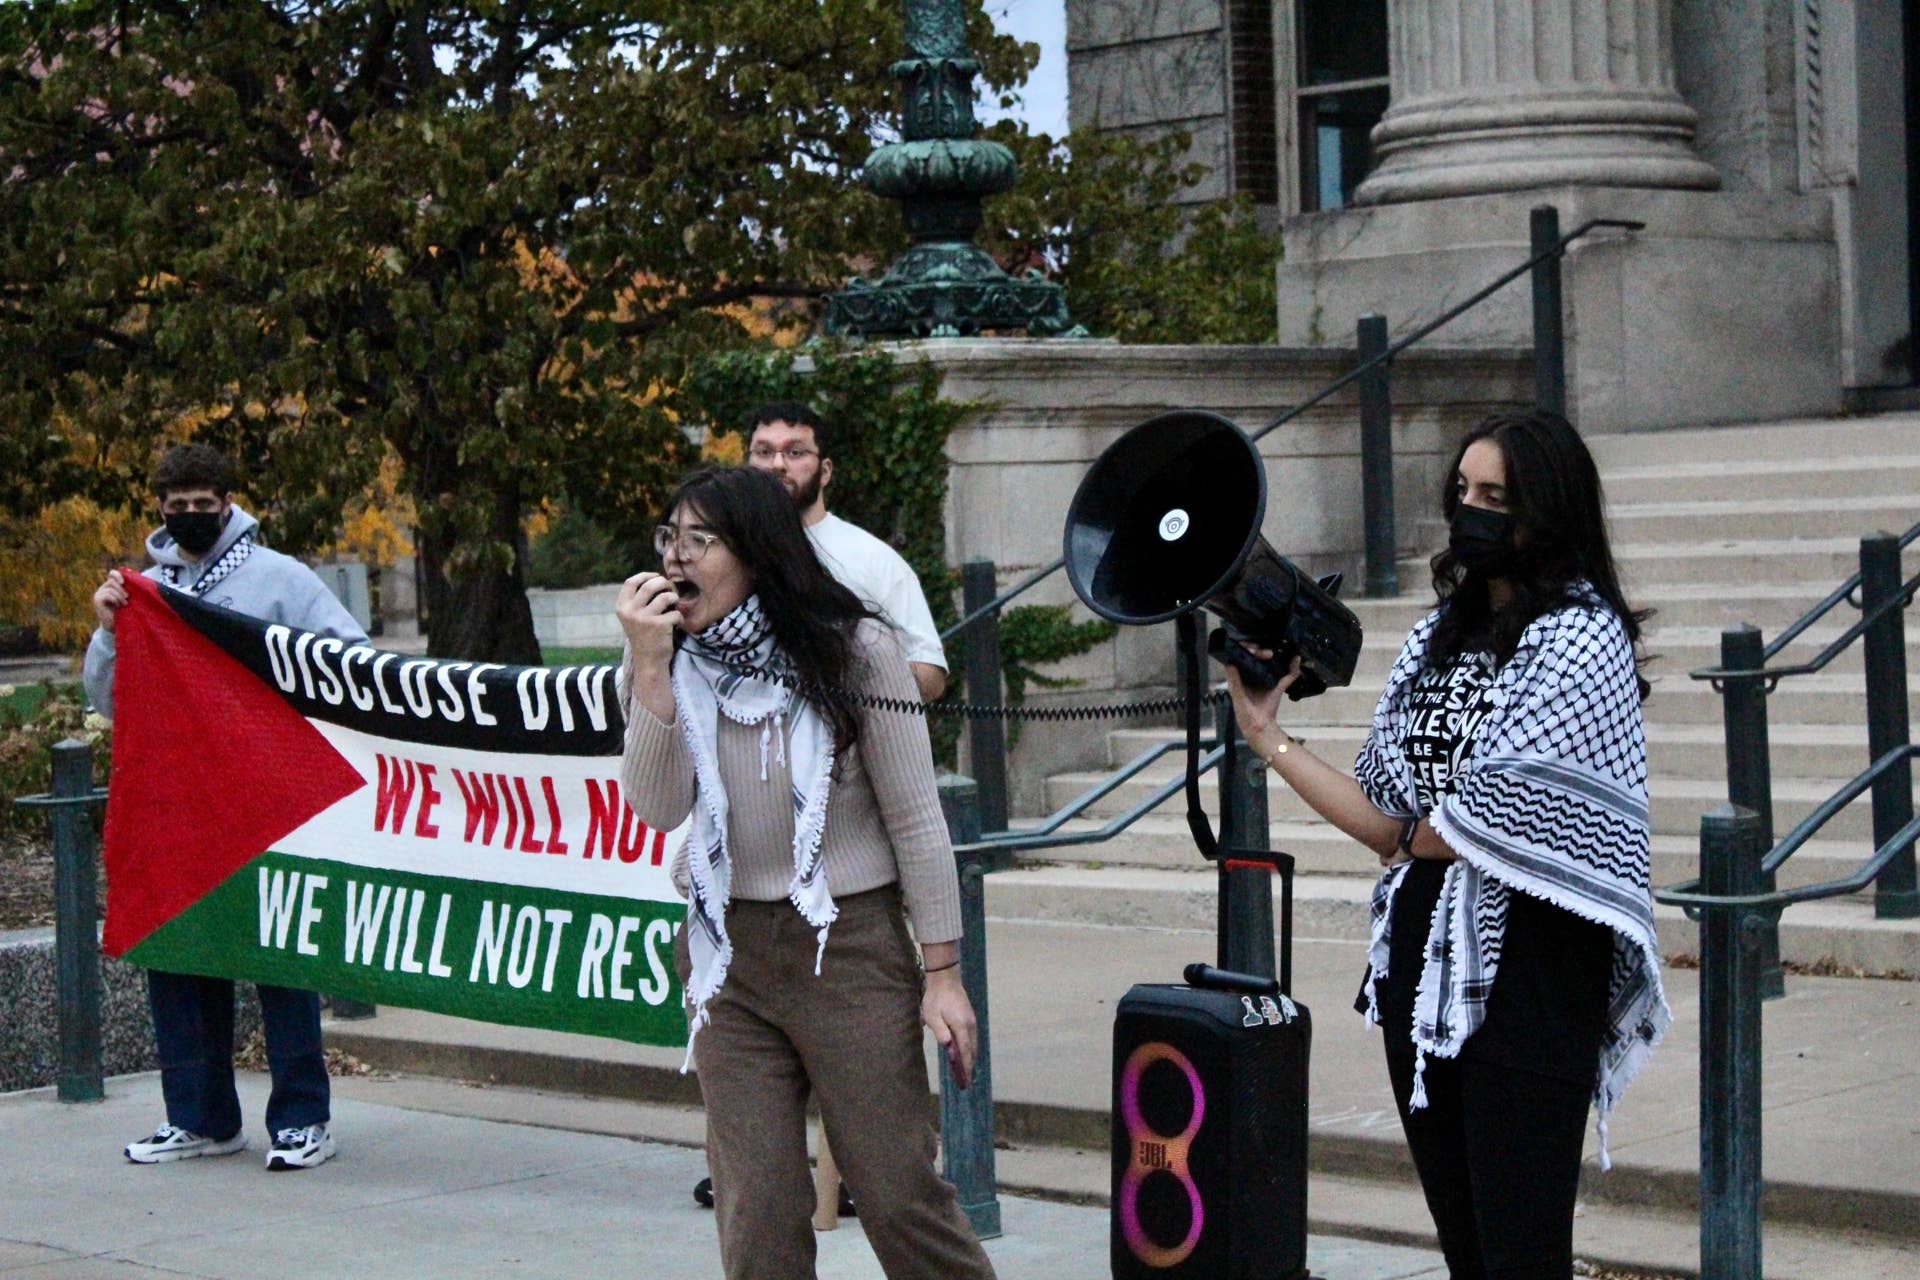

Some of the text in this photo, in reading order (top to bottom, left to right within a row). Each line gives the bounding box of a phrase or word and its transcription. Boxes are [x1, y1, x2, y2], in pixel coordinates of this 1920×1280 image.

[1458, 652, 1479, 664] THE
[265, 624, 625, 732] DISCLOSE DIV
[1415, 665, 1480, 688] RIVER
[1424, 692, 1446, 705] THE
[1413, 743, 1433, 756] BE
[374, 753, 441, 839] WE
[451, 768, 568, 856] WILL
[258, 867, 685, 1008] WE WILL NOT RES
[1140, 1141, 1172, 1170] JBL
